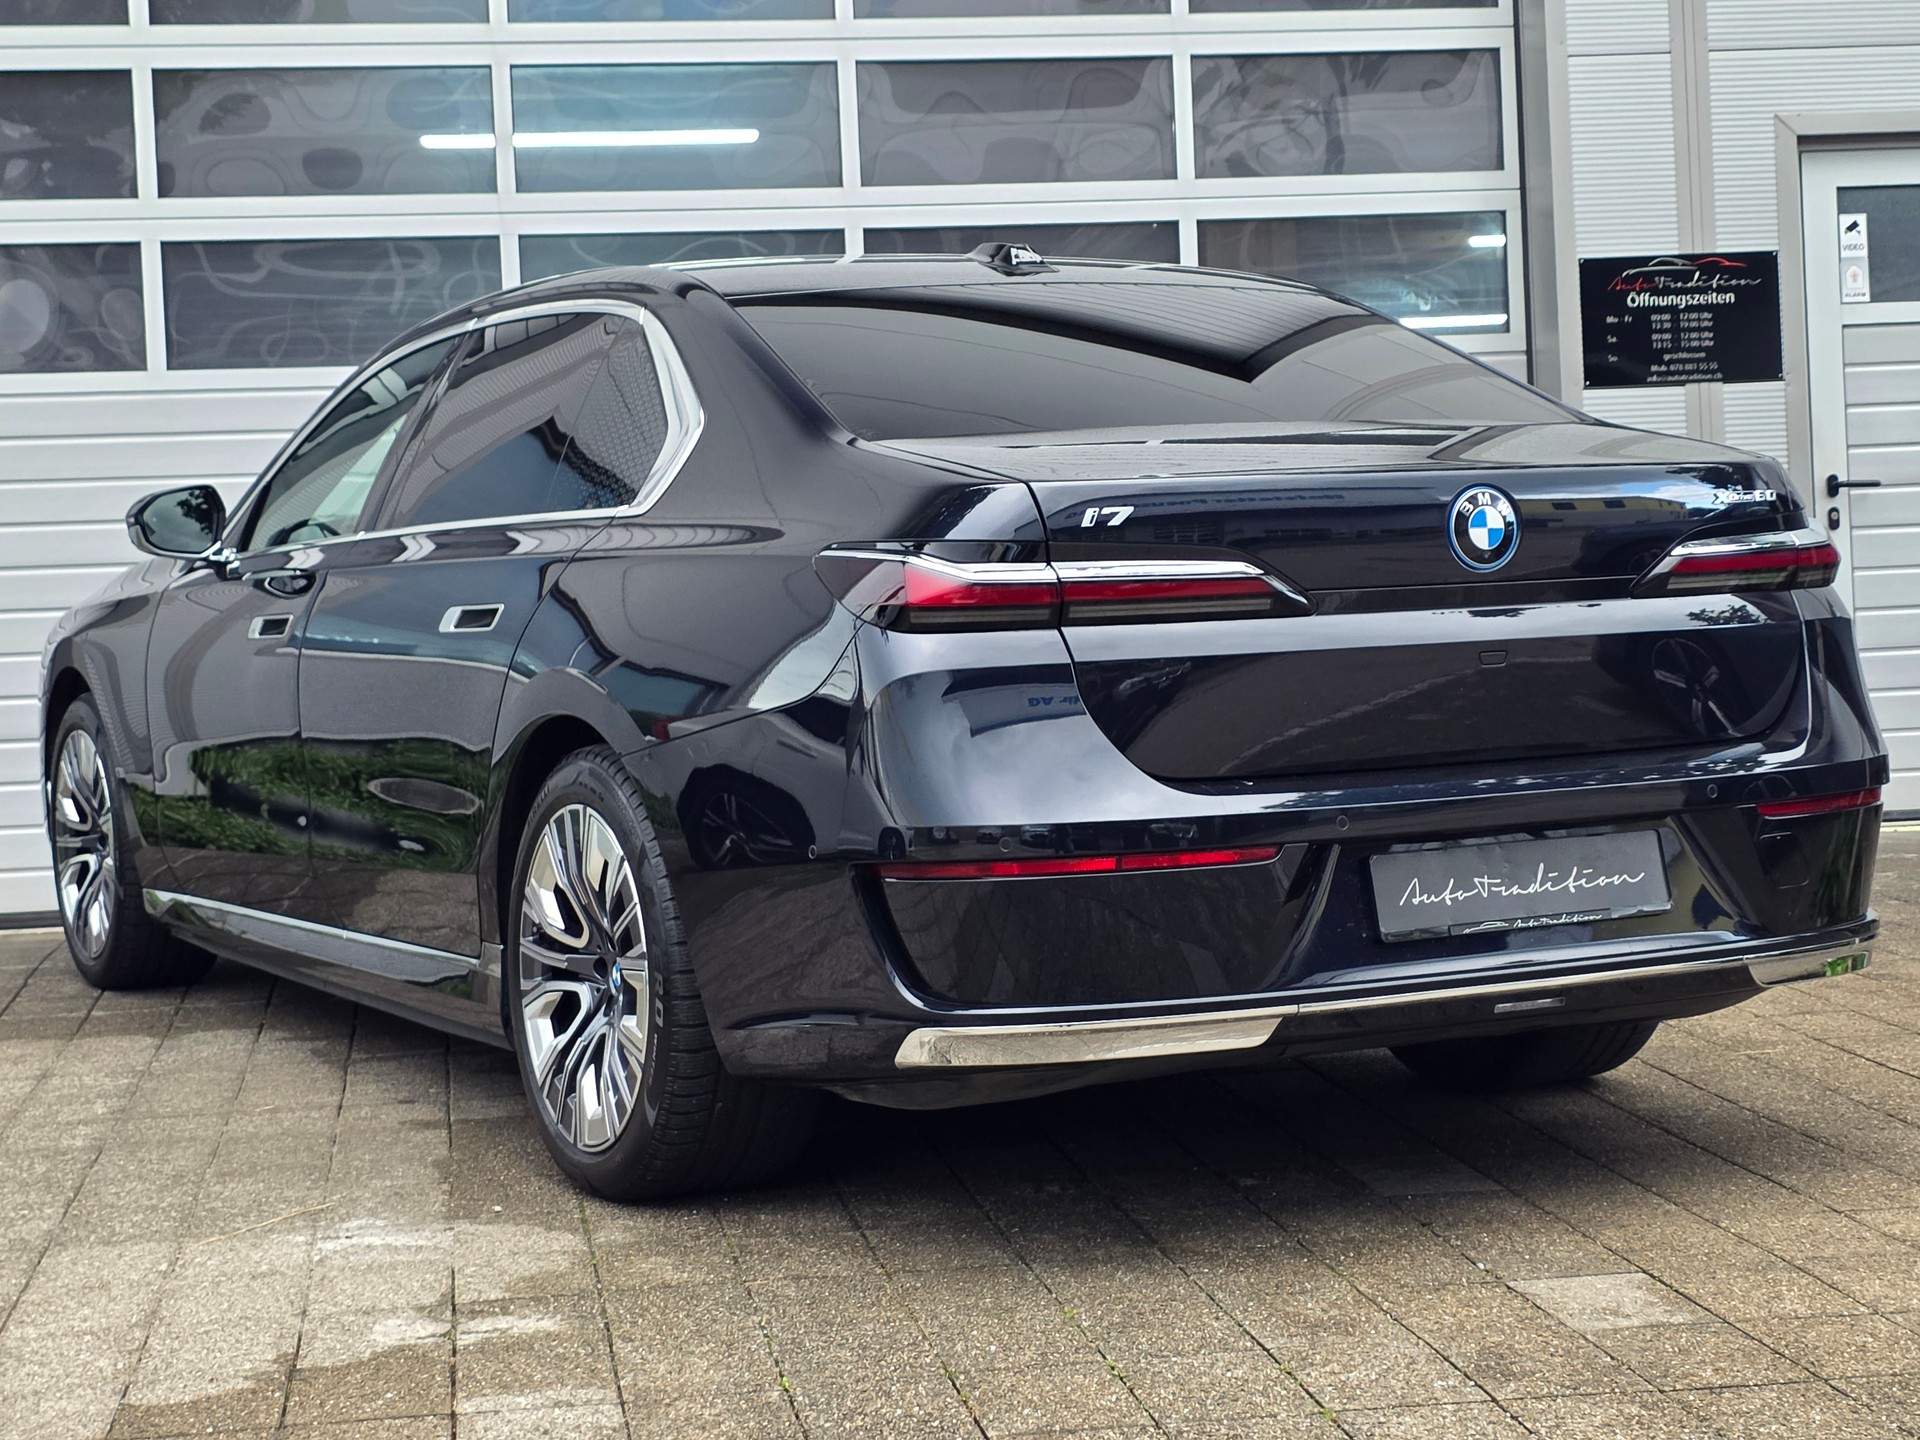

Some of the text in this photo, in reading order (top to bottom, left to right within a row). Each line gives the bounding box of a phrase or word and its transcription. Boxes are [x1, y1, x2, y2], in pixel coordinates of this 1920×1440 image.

[1842, 243, 1865, 251] VIDEO
[1626, 291, 1736, 309] Öffnungszeiten
[1459, 492, 1511, 517] BMW
[1080, 506, 1135, 527] i7
[1399, 862, 1646, 906] AutoTradition
